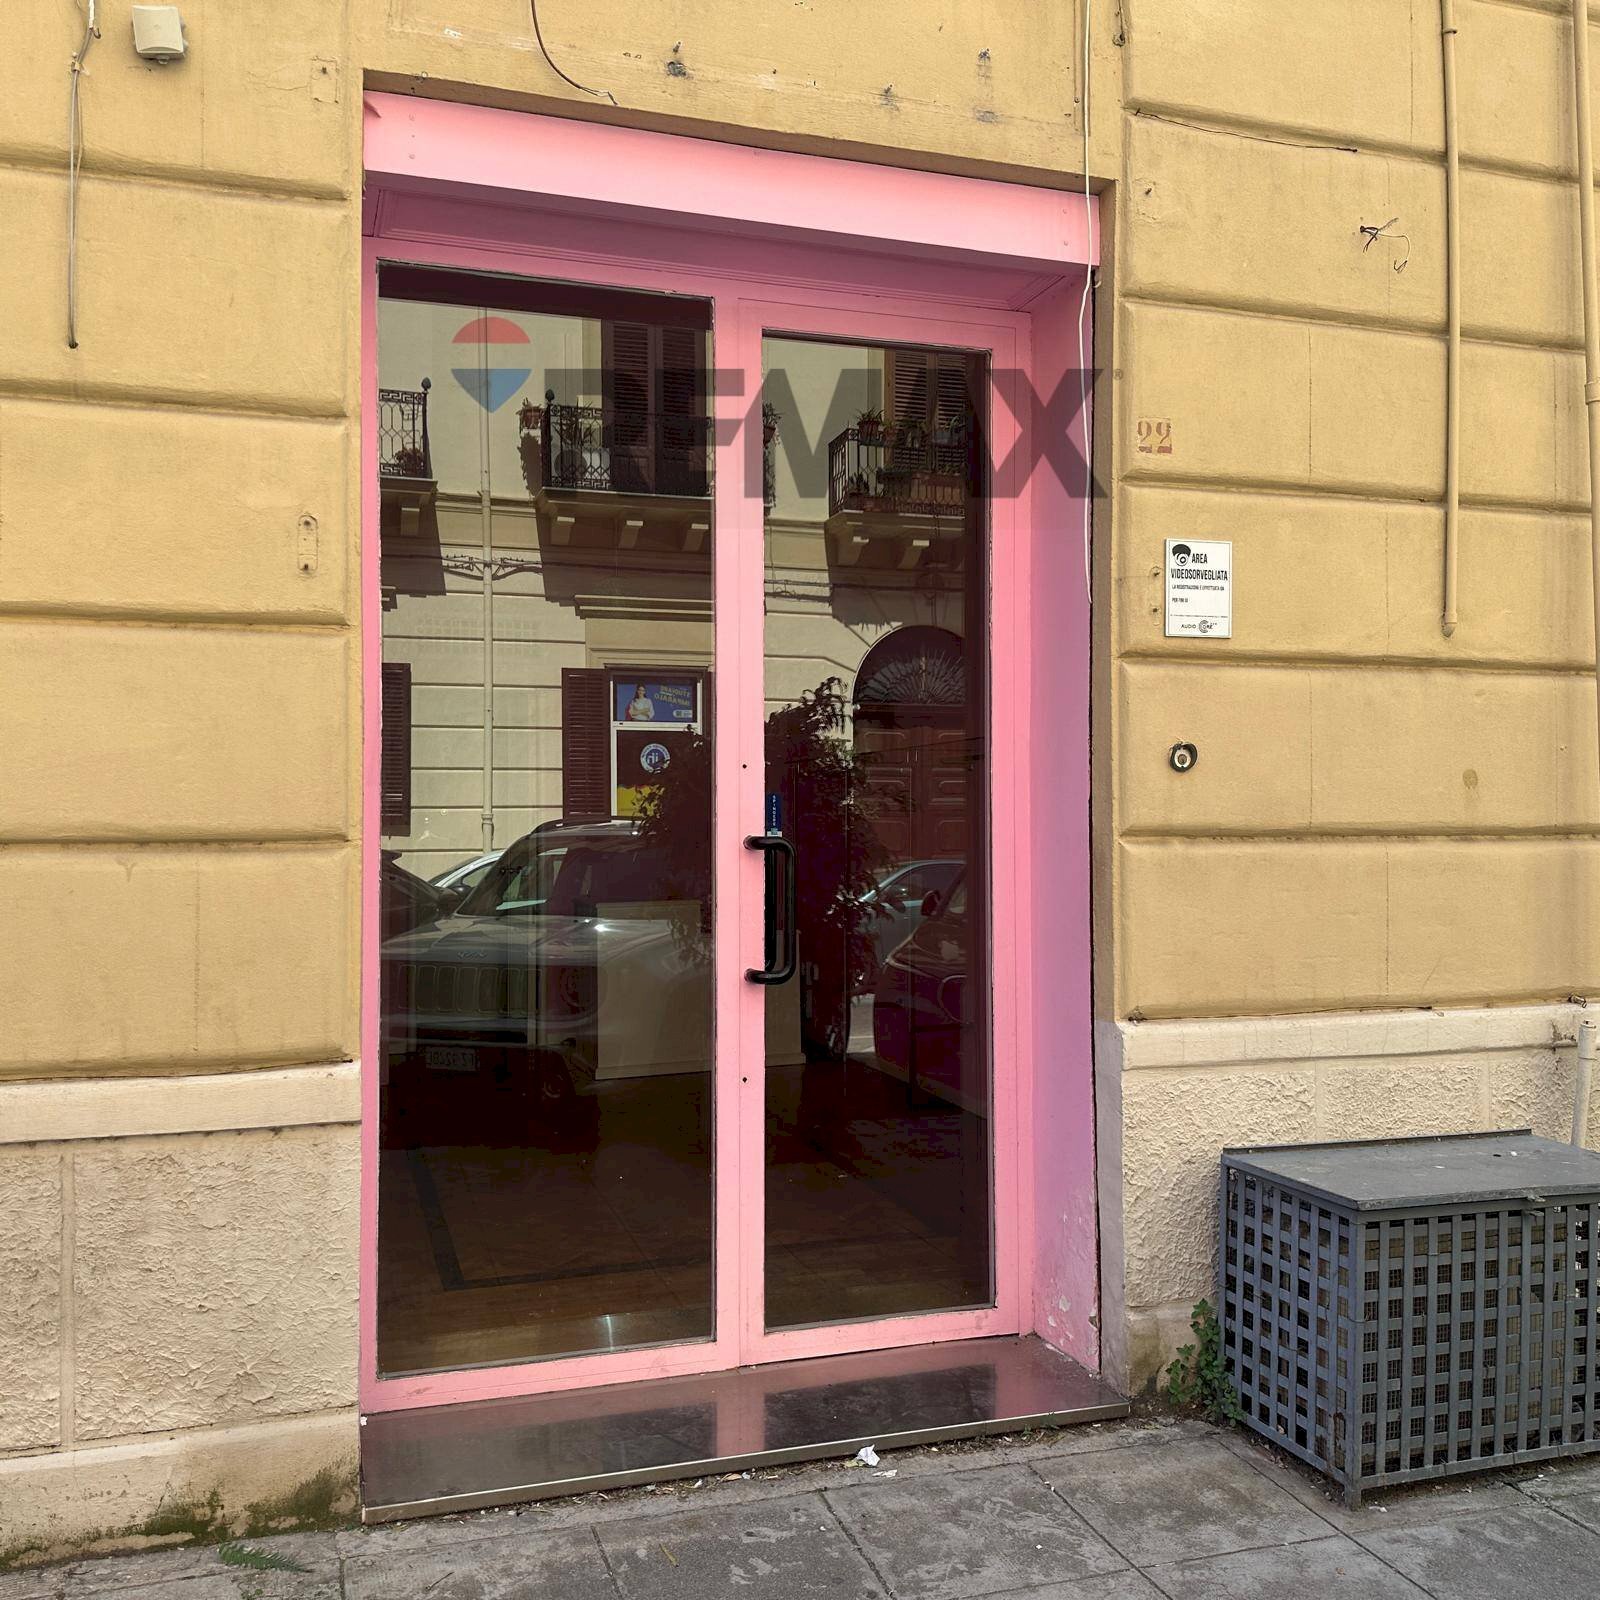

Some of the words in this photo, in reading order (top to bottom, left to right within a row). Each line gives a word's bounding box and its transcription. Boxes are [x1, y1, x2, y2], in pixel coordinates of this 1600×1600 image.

[1138, 420, 1172, 454] 22
[1192, 553, 1208, 564] AREA
[1171, 568, 1228, 581] VIDEOSORVEGLIATA
